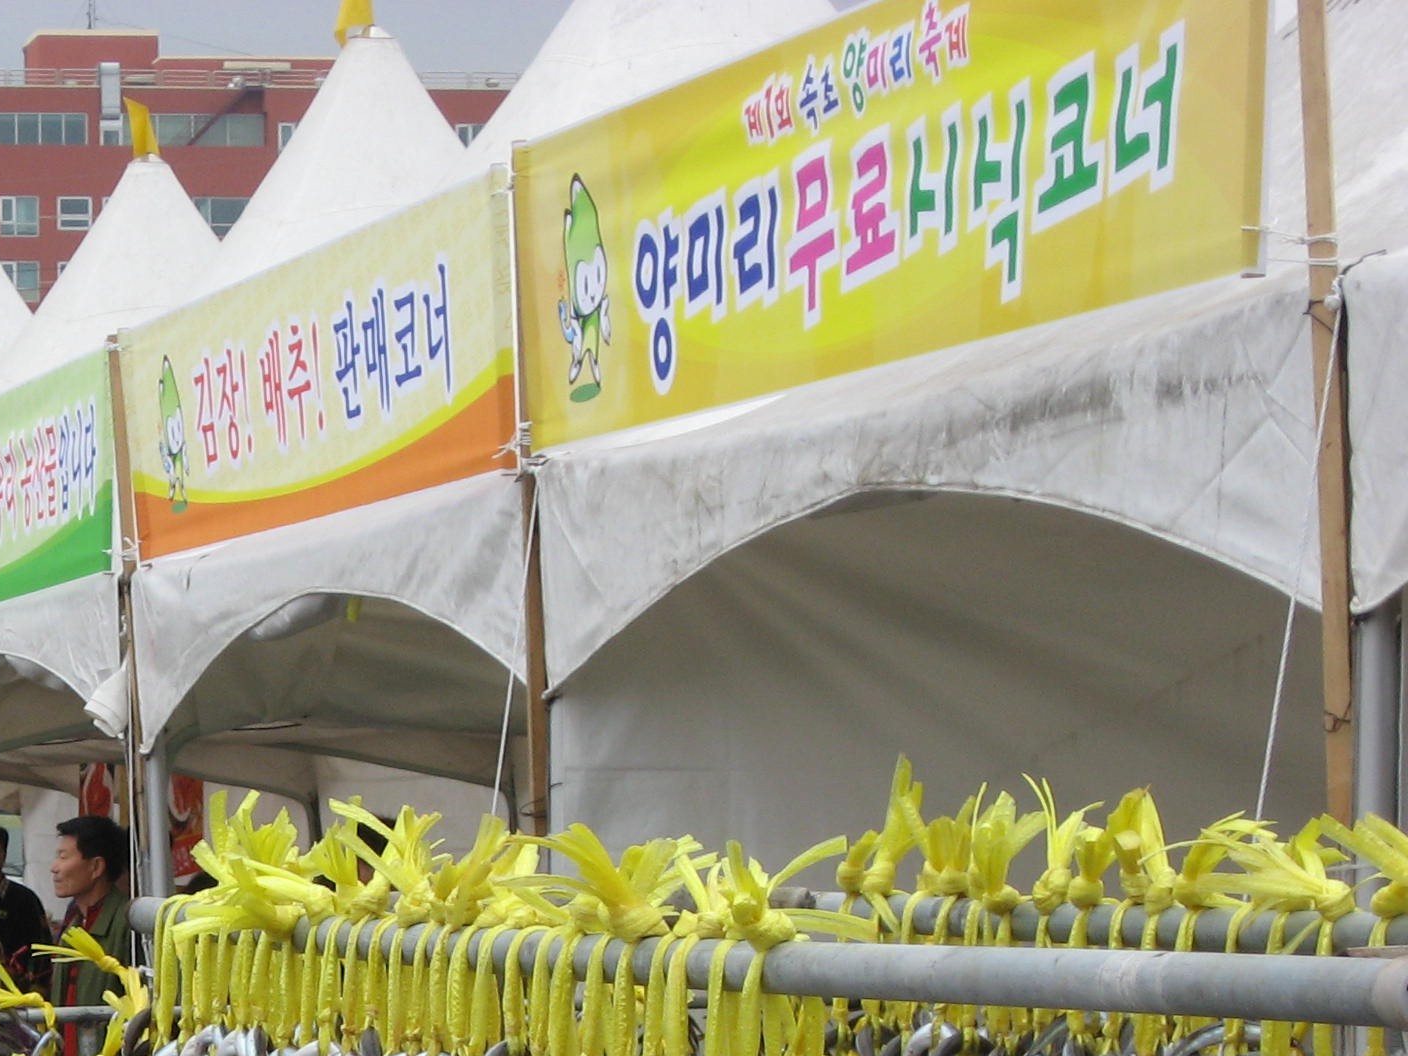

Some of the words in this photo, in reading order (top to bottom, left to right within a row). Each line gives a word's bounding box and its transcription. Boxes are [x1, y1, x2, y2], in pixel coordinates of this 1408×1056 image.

[744, 84, 793, 139] 제1회
[799, 63, 840, 130] 속초
[842, 31, 913, 113] 양미리
[918, 3, 969, 78] 축제
[193, 347, 254, 468] 김장!
[259, 320, 327, 447] 배추!
[333, 263, 452, 419] 판매코너
